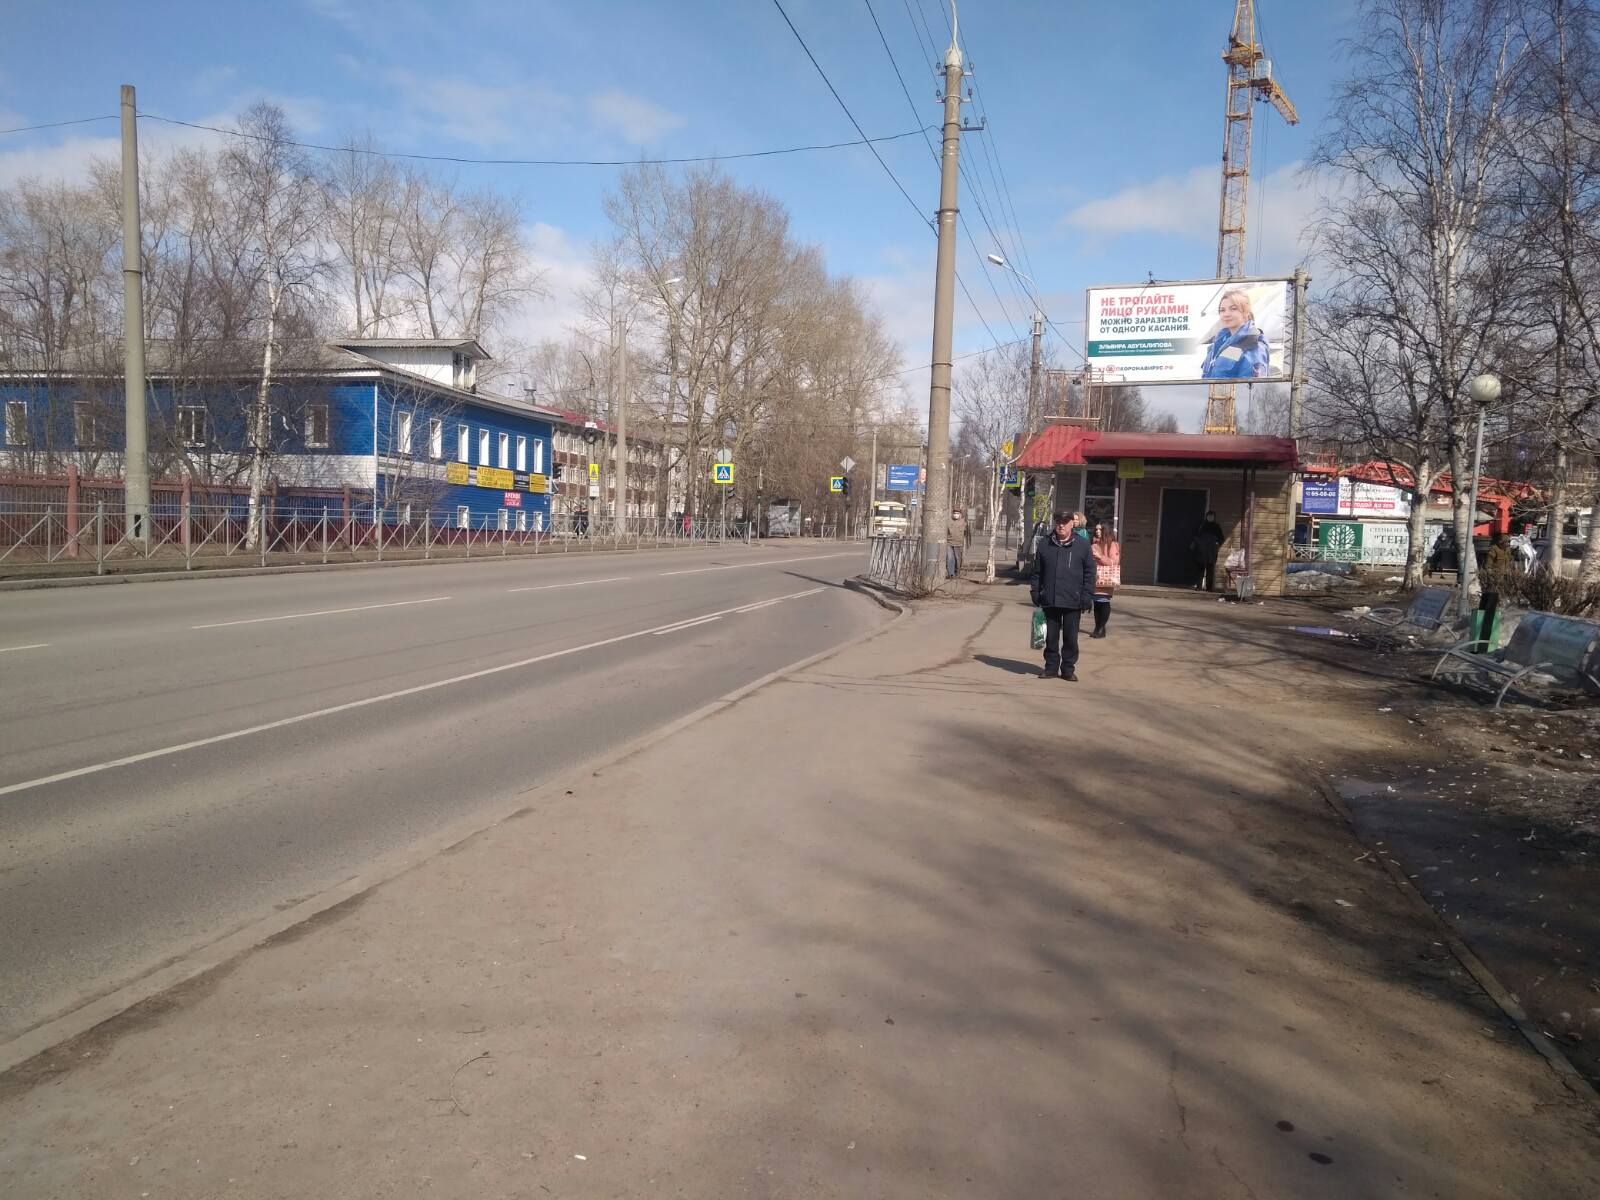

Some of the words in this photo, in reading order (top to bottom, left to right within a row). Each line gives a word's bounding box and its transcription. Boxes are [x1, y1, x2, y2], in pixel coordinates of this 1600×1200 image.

[1101, 297, 1115, 306] НЕ
[1119, 293, 1175, 306] ТРОГАЙТЕ
[1101, 307, 1133, 318] ЛИЦО
[1136, 304, 1189, 316] РУКАМИ!
[1100, 317, 1132, 326] МОЖНО
[1135, 315, 1189, 325] ЗАРАЗИТЬСЯ
[1100, 326, 1110, 334] ОТ
[1112, 325, 1146, 334] ОДНОГО
[1148, 323, 1191, 333] КАСАНИЯ.
